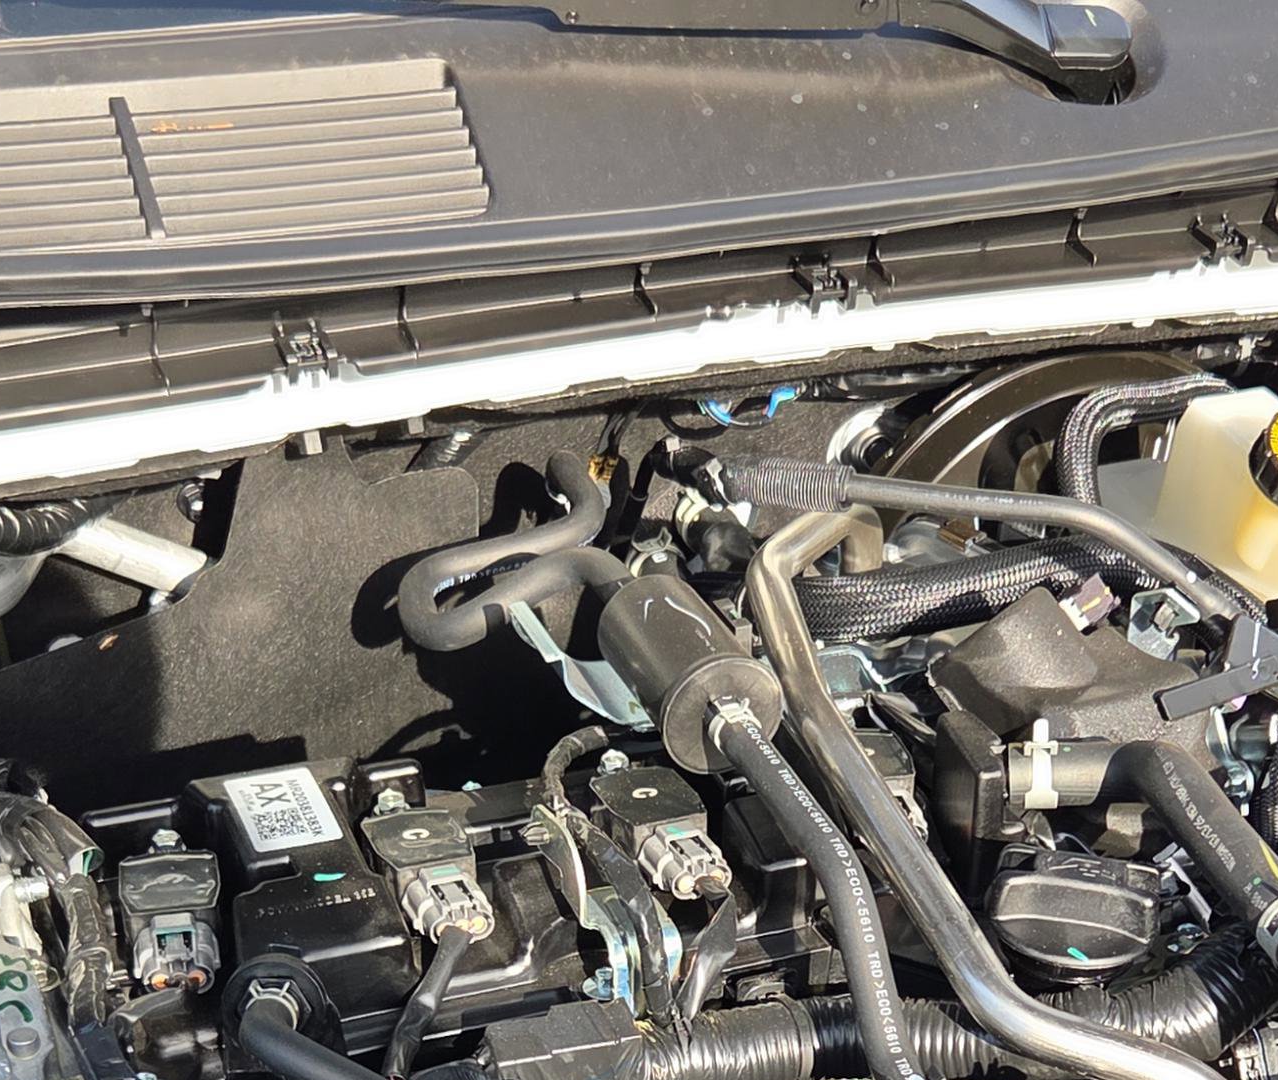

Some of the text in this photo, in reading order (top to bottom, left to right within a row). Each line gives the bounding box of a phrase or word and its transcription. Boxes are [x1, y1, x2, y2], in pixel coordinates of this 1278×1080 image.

[250, 783, 292, 808] AX
[829, 837, 876, 944] TRD>ECO<5610
[867, 950, 903, 1054] TRD>ECO<5610
